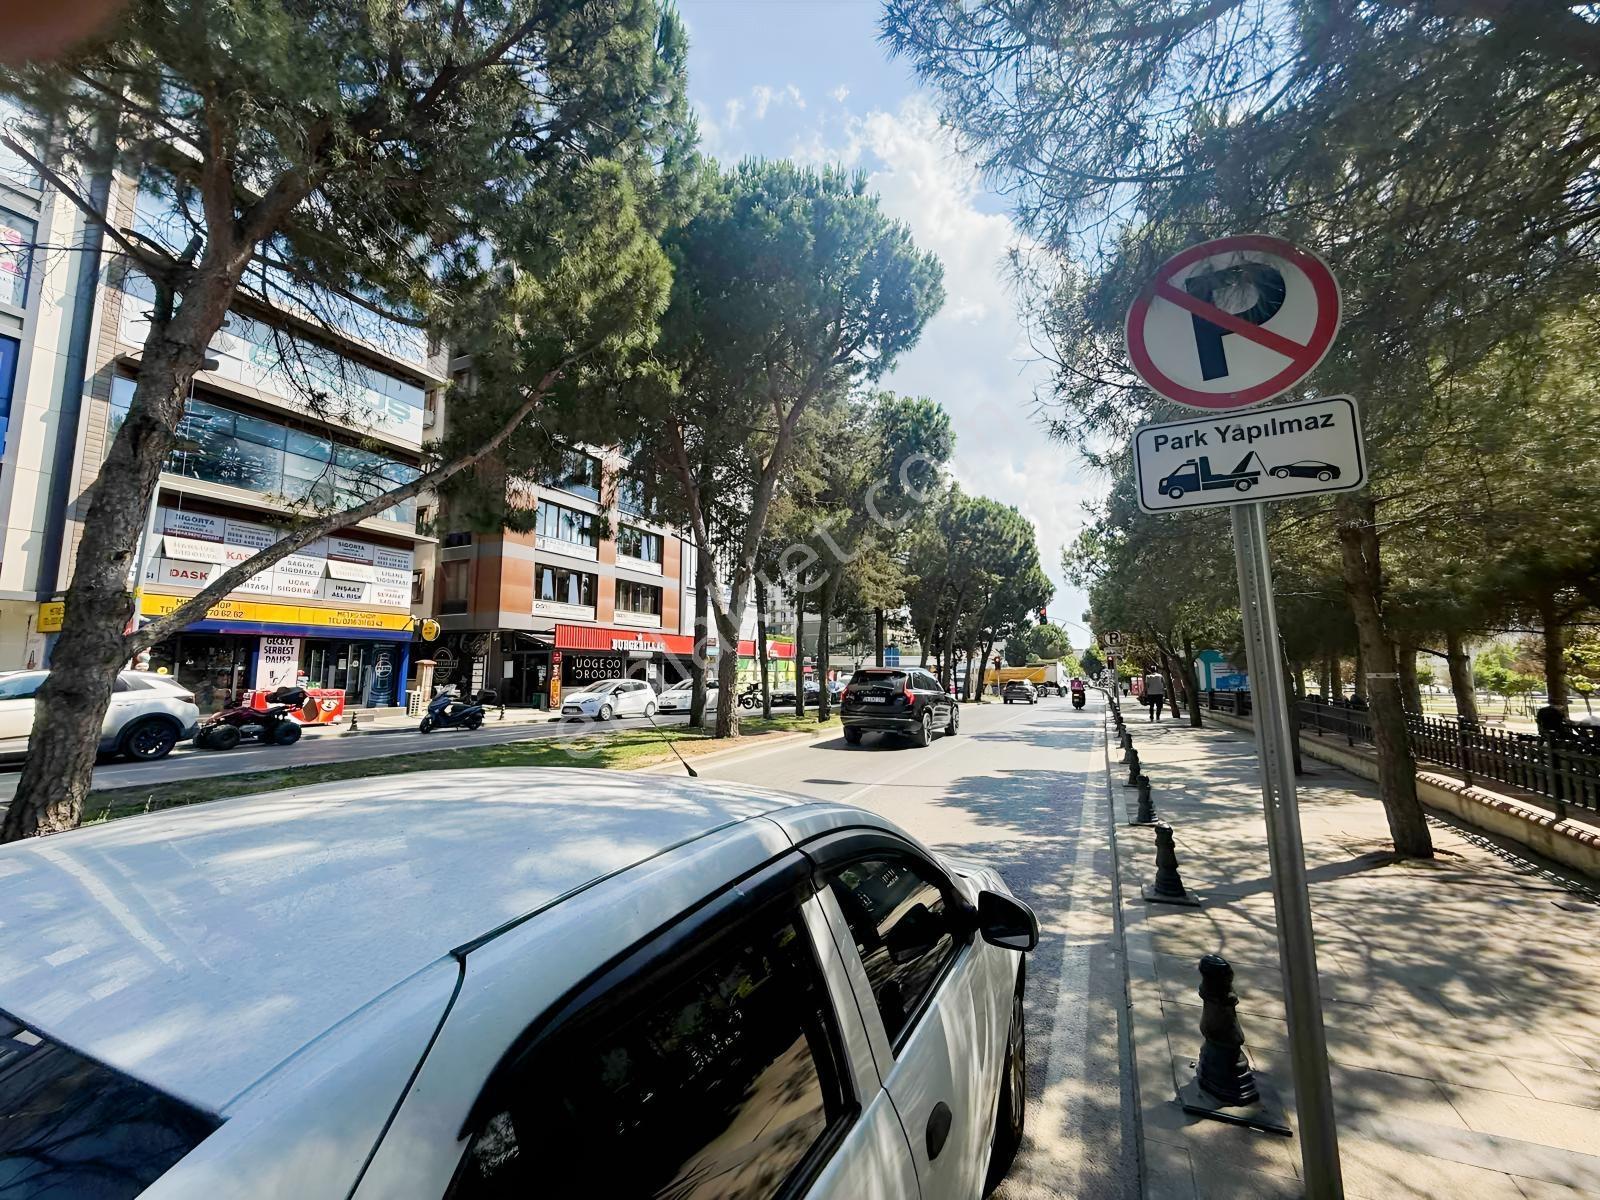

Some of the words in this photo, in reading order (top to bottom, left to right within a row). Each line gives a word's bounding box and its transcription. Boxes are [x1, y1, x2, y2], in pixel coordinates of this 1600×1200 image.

[1184, 262, 1286, 382] P
[1153, 429, 1209, 453] Park
[1214, 413, 1335, 444] Yapılmaz
[169, 568, 210, 580] DASK
[264, 645, 295, 655] SERBEST
